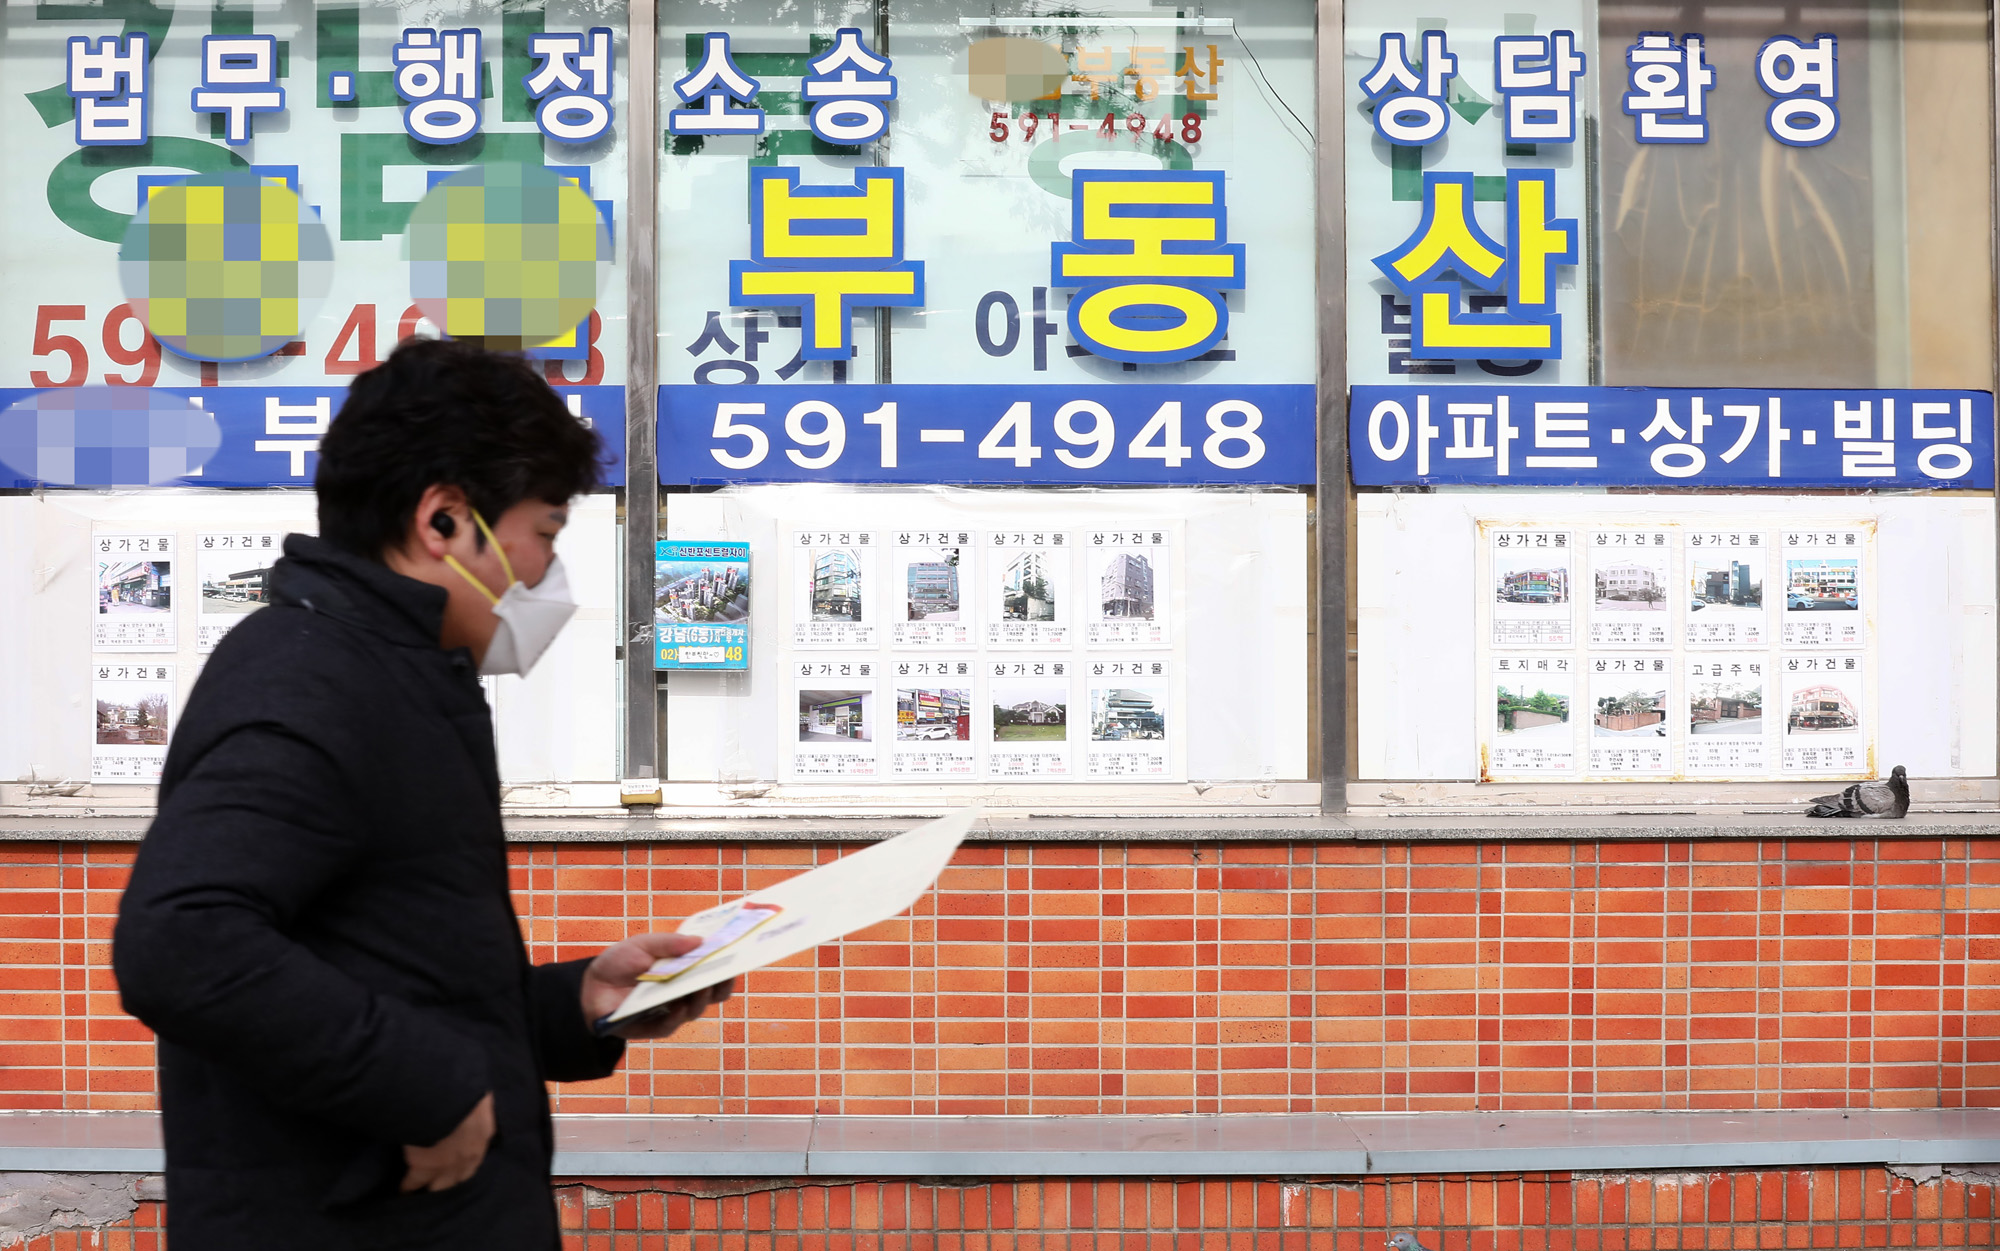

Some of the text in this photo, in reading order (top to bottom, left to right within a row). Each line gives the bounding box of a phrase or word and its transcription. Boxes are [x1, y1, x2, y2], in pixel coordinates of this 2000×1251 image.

[669, 28, 898, 145] 소송
[989, 112, 1203, 143] 591-4948
[709, 399, 1267, 470] 591-4948
